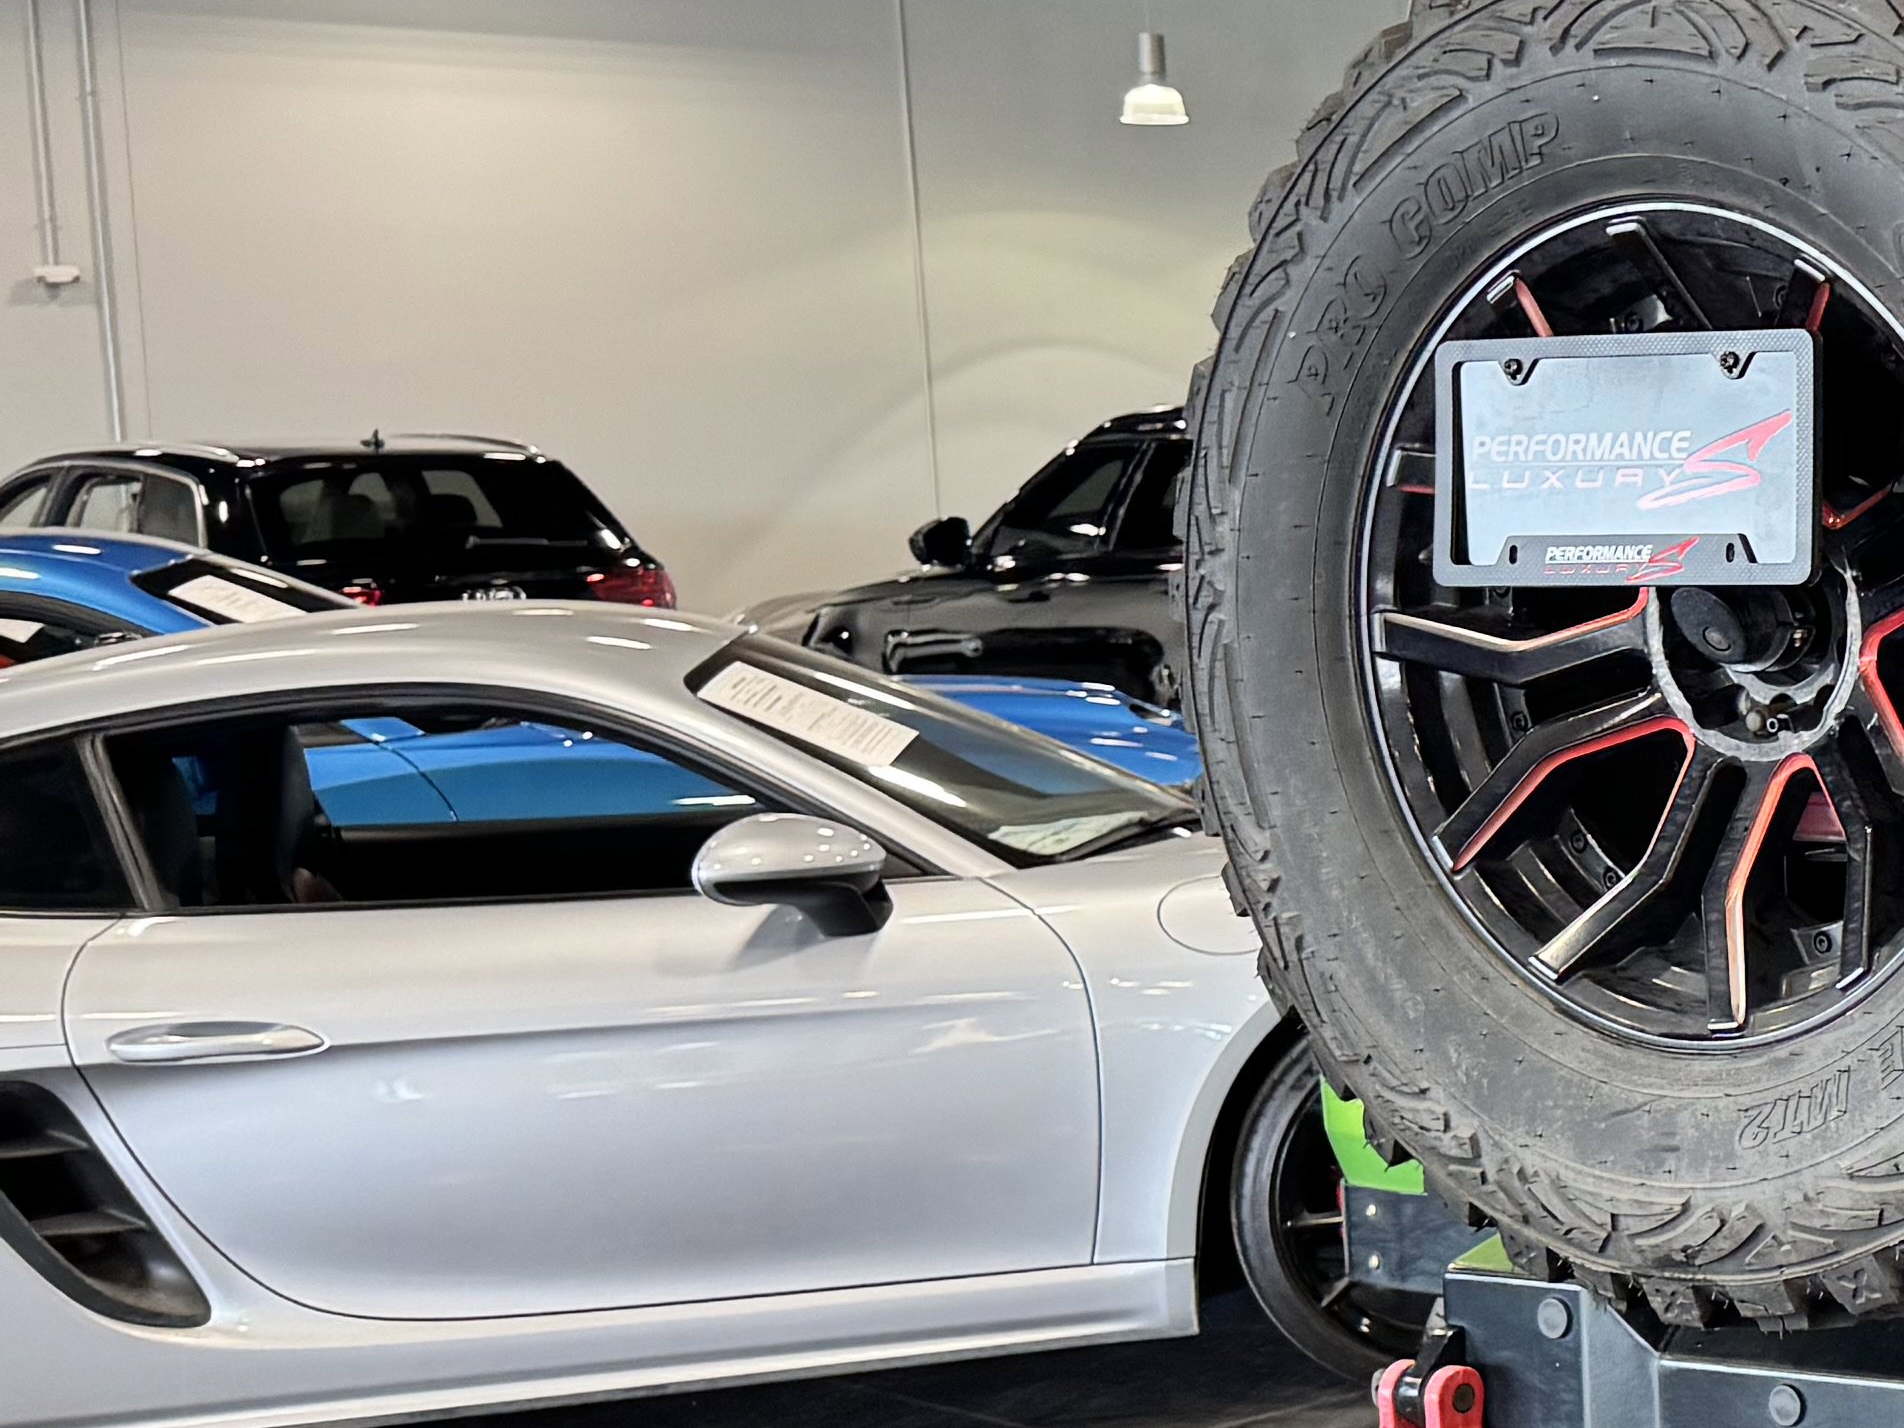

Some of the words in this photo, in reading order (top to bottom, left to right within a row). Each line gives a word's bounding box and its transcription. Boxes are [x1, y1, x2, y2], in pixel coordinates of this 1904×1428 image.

[1389, 112, 1560, 261] COMP
[1473, 430, 1692, 461] PERFORMANCE
[1467, 468, 1684, 489] LUXURY
[1545, 544, 1654, 563] PERFORMANCE
[1740, 1065, 1850, 1149] MT2
